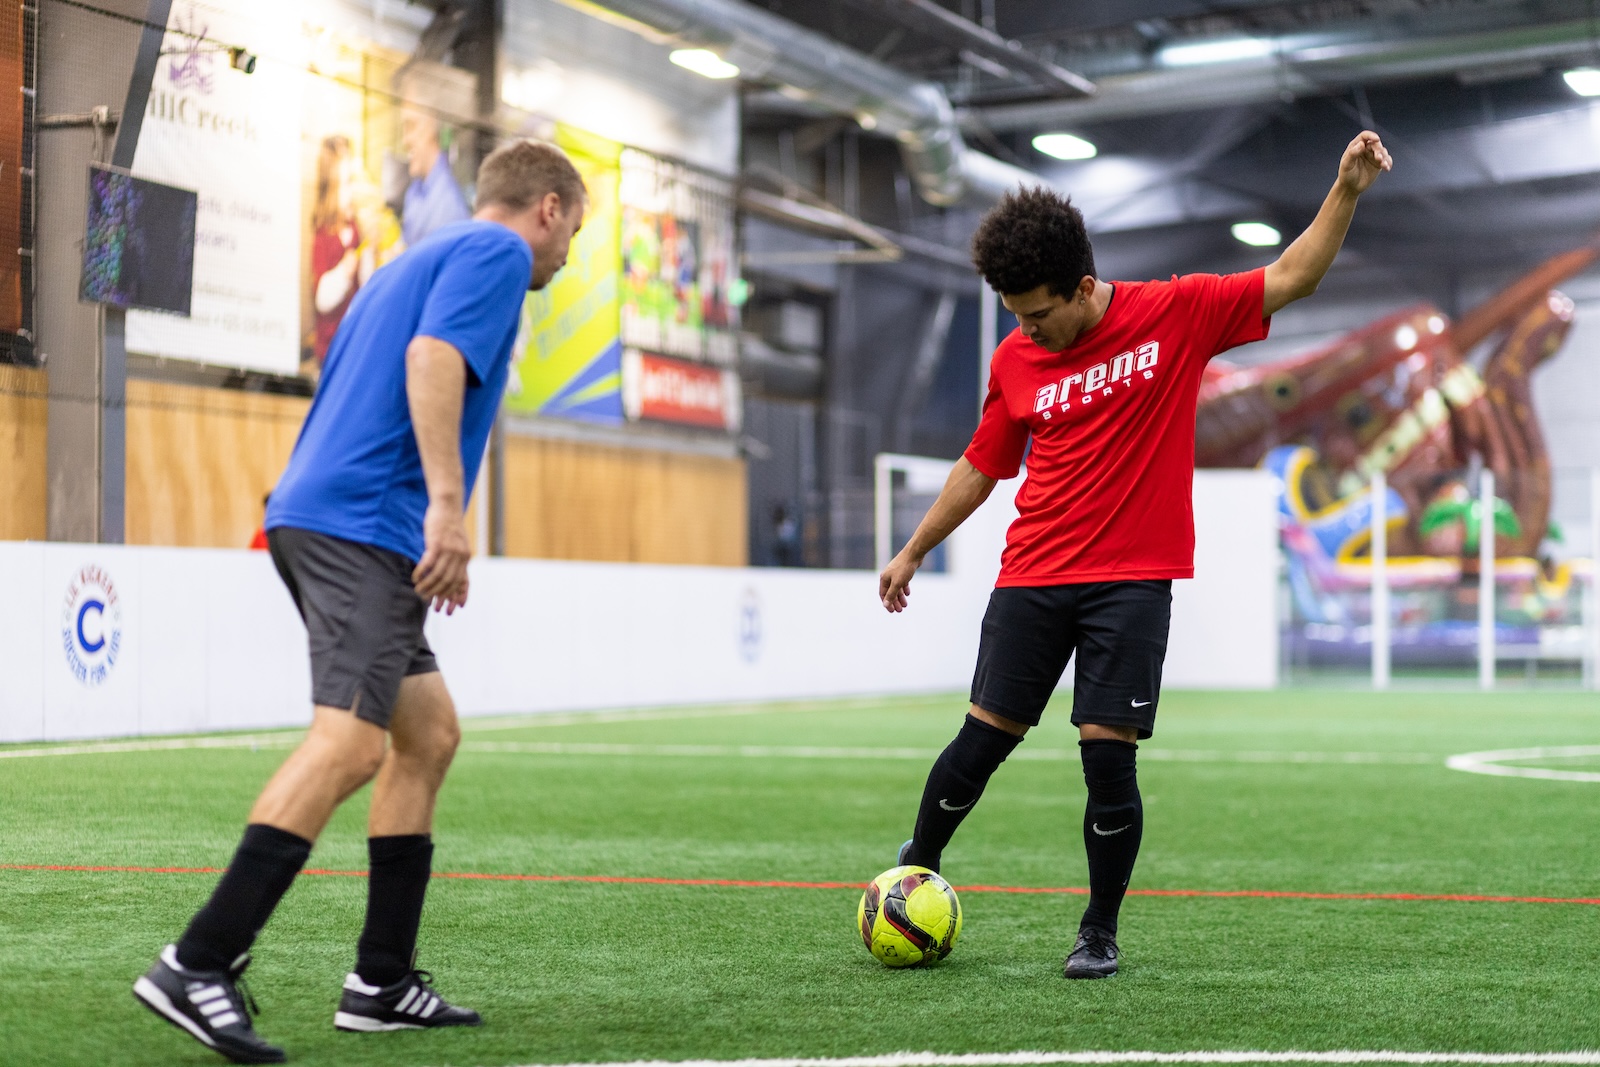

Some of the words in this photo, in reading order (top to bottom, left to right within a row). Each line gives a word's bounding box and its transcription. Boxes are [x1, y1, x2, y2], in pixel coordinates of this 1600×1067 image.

[1033, 340, 1159, 413] arena
[1042, 369, 1154, 420] SPORTS
[77, 599, 105, 653] C
[62, 627, 87, 684] SOCCER
[90, 663, 107, 686] FOR
